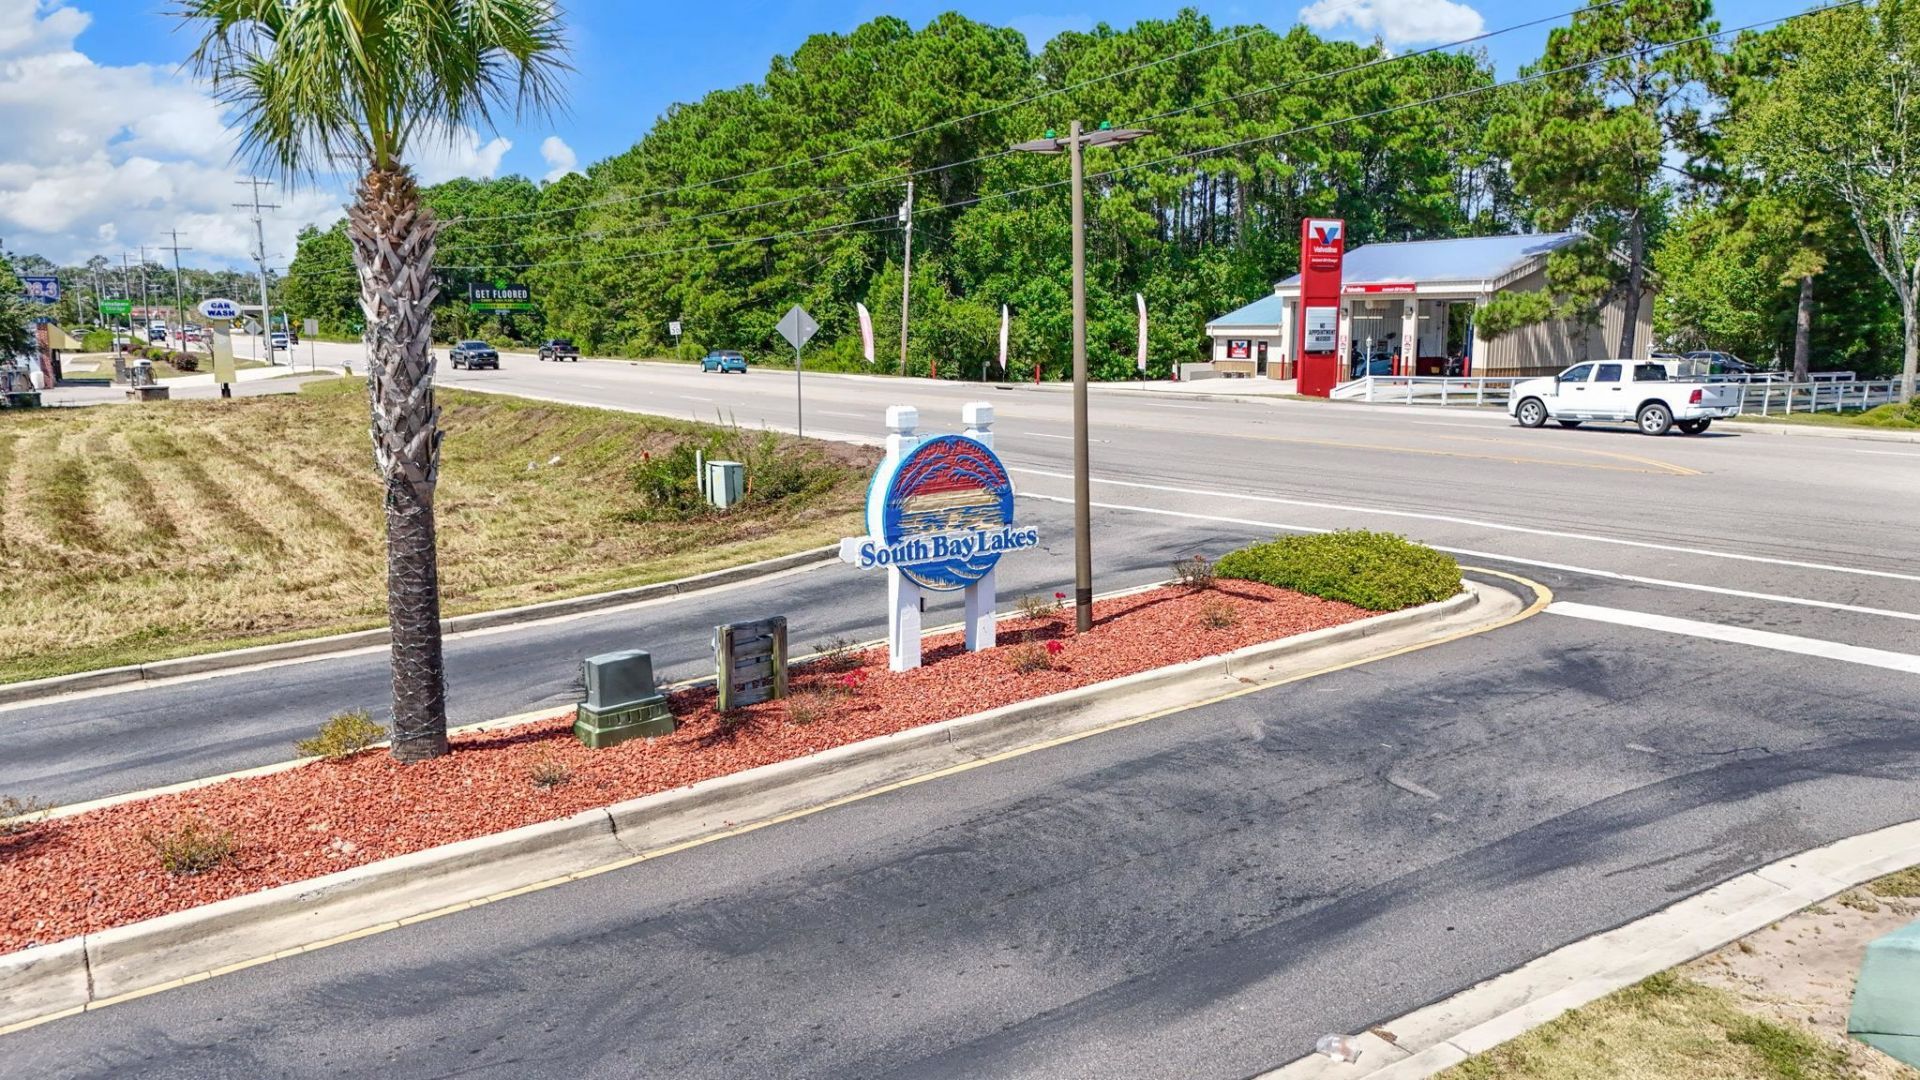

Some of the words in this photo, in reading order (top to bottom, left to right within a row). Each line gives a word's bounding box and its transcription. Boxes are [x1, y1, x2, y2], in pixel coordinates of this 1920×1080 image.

[475, 290, 490, 299] GET
[493, 290, 528, 299] FLOORED
[860, 538, 929, 567] South
[931, 535, 975, 558] Bay
[977, 528, 1037, 553] Lakes
